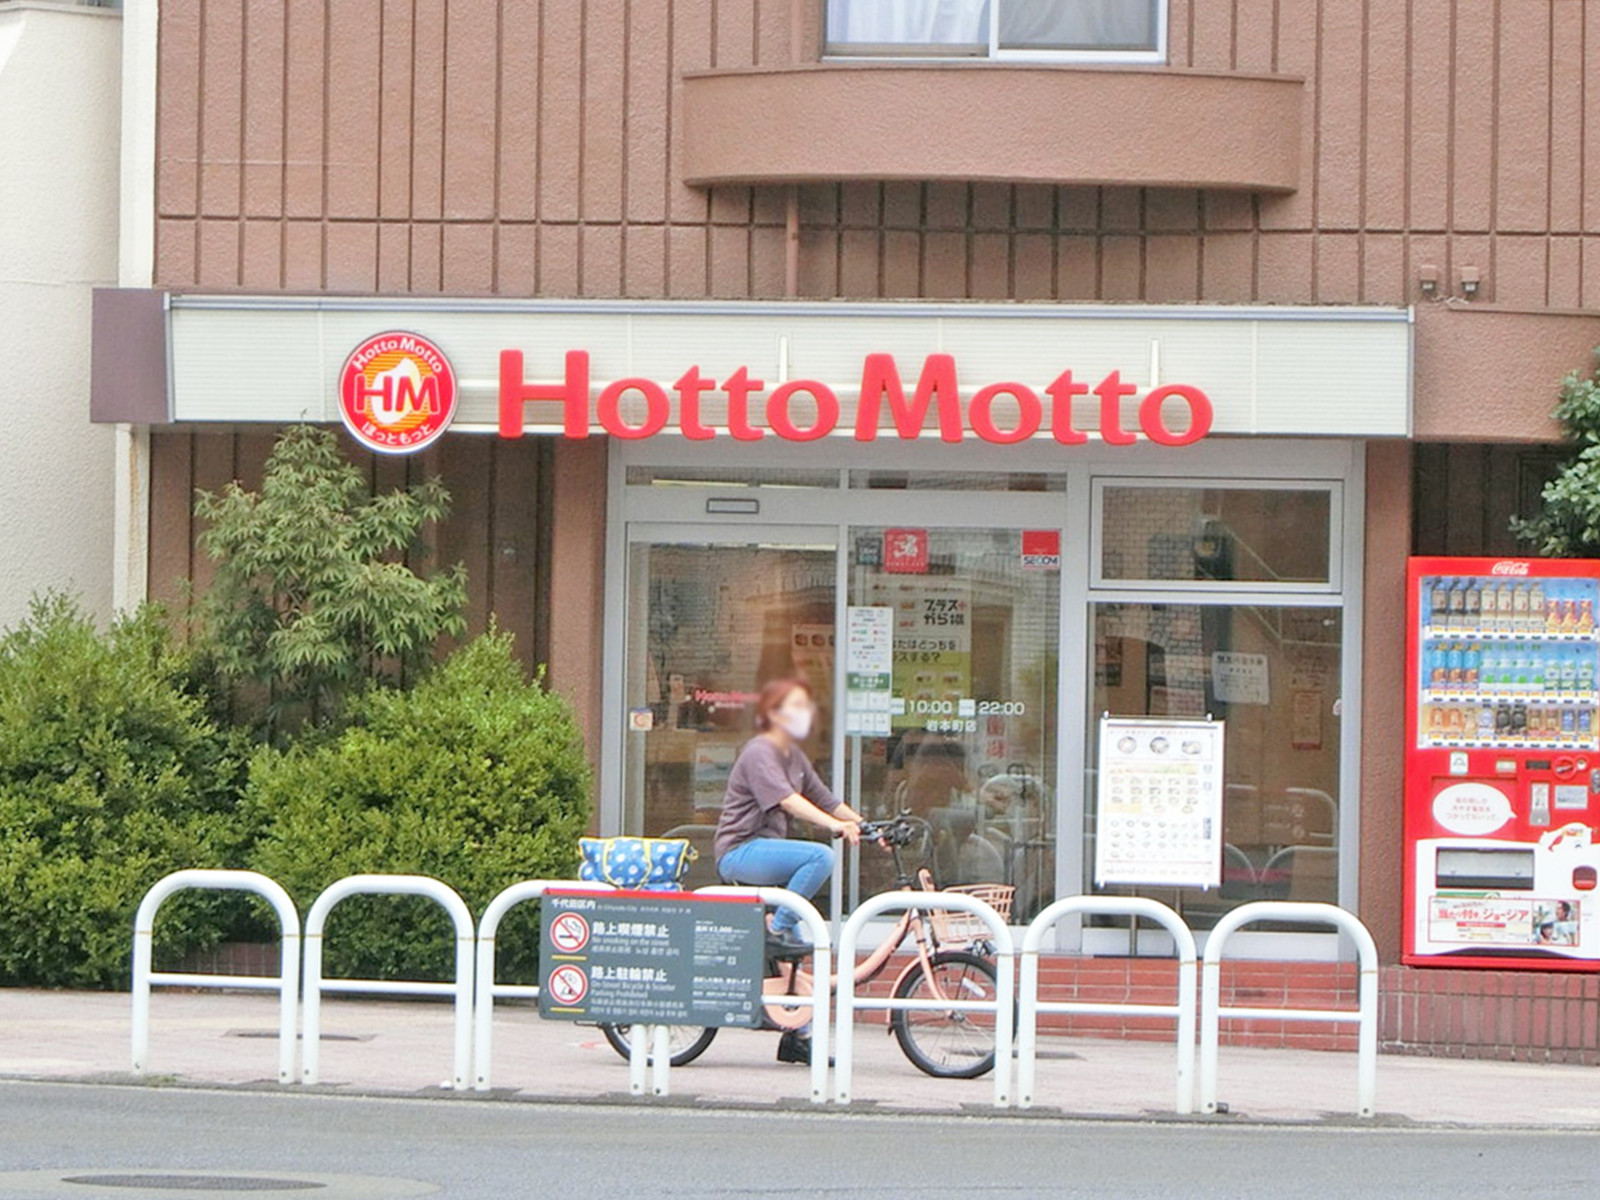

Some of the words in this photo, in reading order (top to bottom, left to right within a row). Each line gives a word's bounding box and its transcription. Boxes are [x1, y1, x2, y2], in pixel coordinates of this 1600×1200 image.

[352, 340, 398, 370] Hotto
[400, 337, 442, 373] Motto
[354, 373, 441, 414] HM
[498, 349, 840, 442] Hotto
[854, 353, 1213, 447] Motto
[361, 421, 434, 446] ほっともっと
[1023, 555, 1058, 565] SECOM
[908, 700, 953, 715] 10:00
[977, 701, 1026, 716] 22:00
[592, 921, 670, 938] 路上喫煙禁止
[591, 966, 667, 983] 路上駐輪禁止
